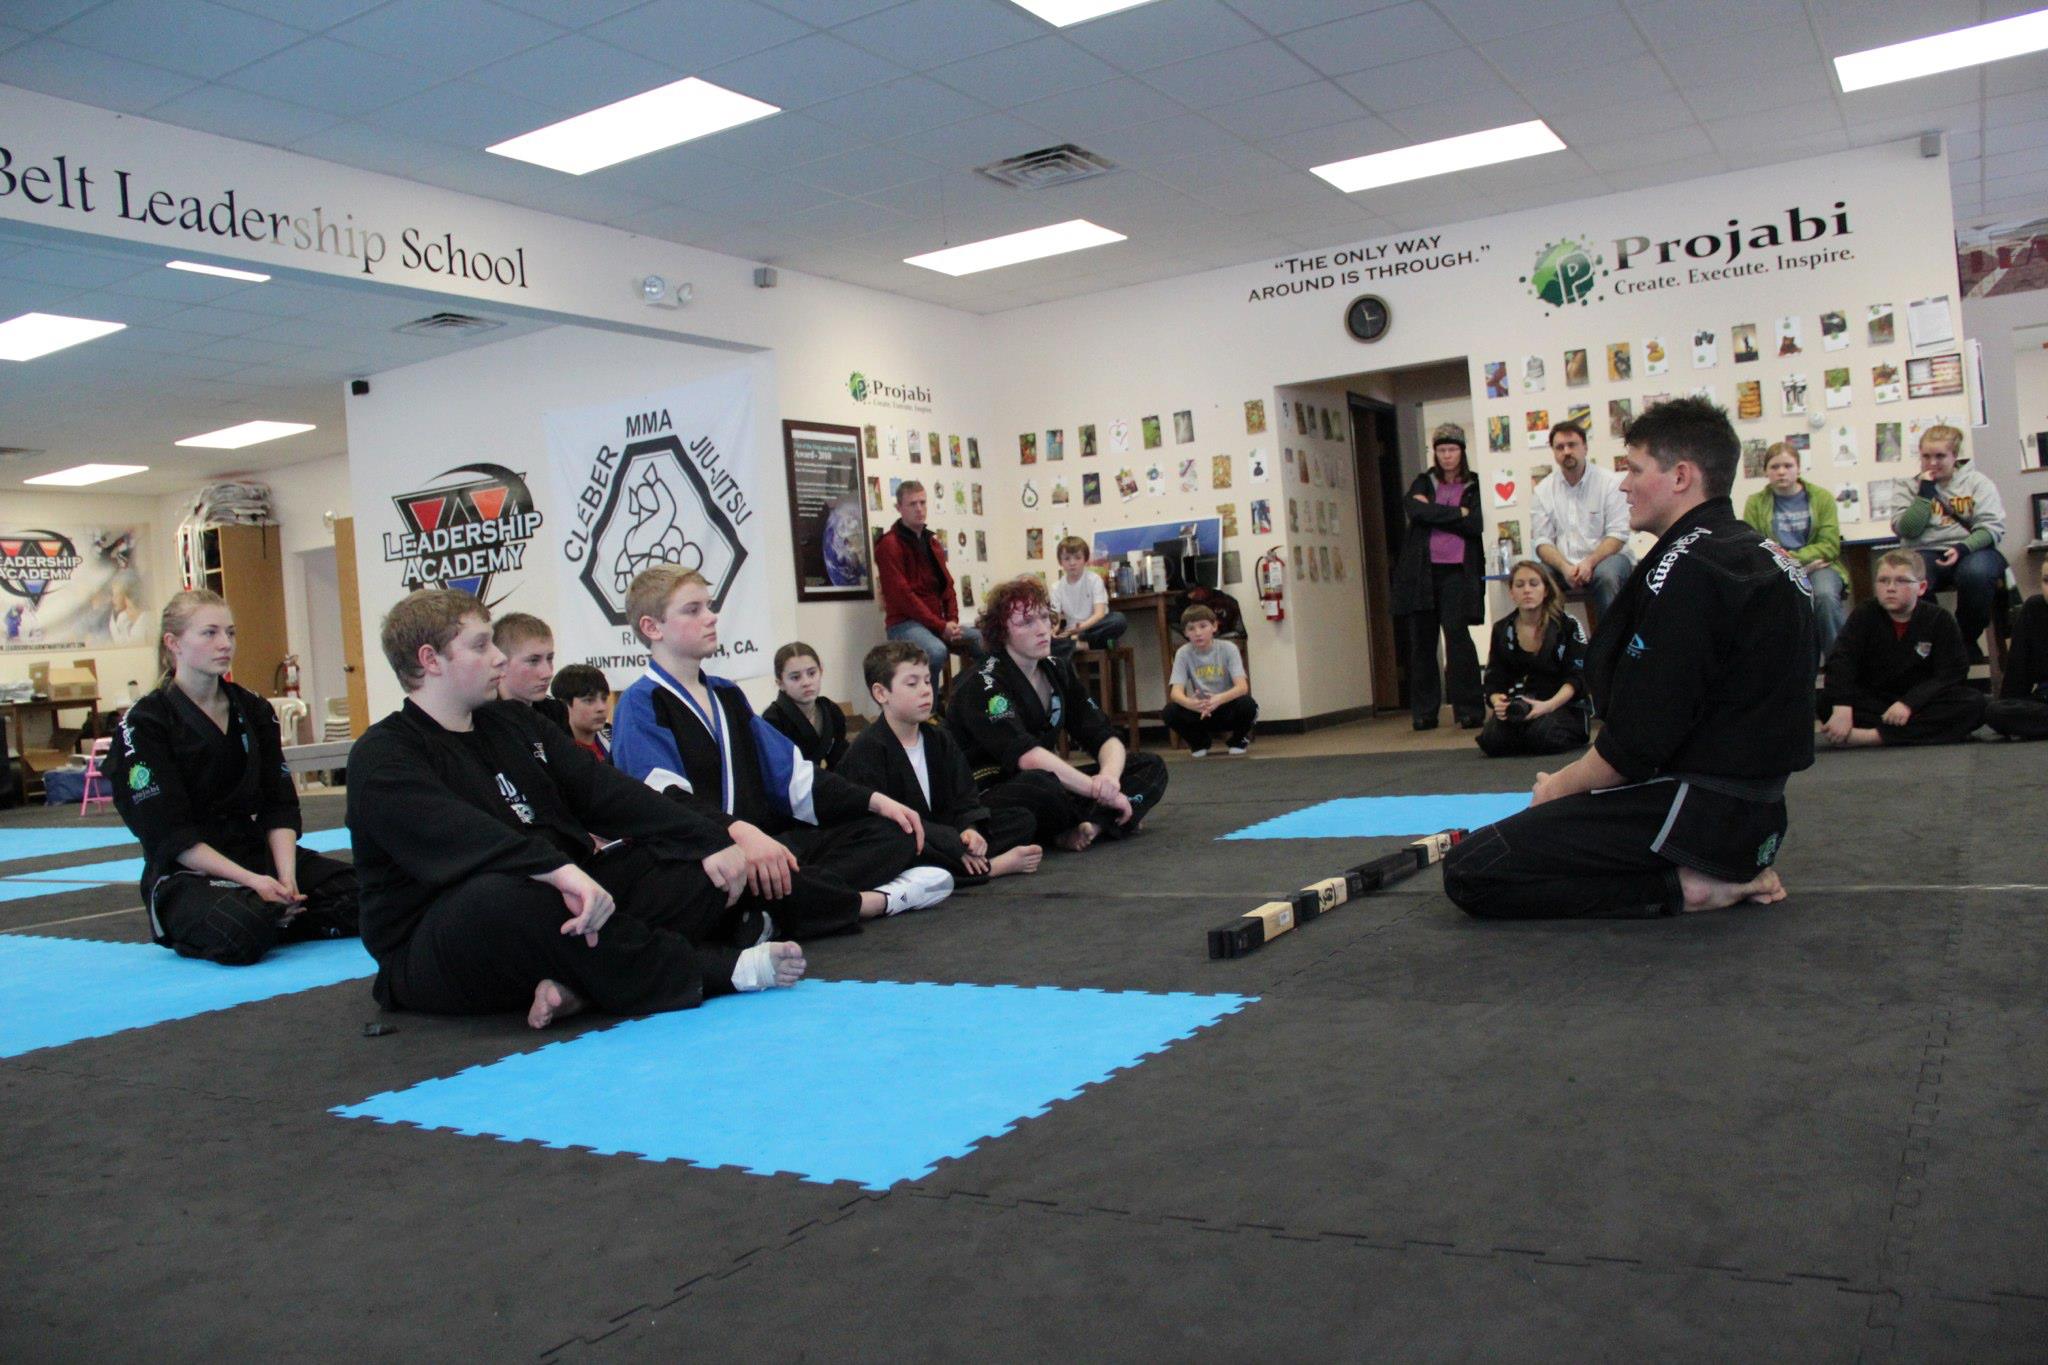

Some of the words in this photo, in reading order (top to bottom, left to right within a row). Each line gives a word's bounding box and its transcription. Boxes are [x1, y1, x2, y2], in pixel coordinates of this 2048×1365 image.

[114, 170, 386, 274] Leadership
[402, 227, 528, 288] School
[1334, 244, 1388, 266] ONLY
[1395, 235, 1442, 255] WAY
[1611, 201, 1854, 272] Projabi
[1248, 275, 1335, 302] AROUND
[1341, 270, 1361, 286] IS
[1614, 277, 1680, 295] Create.
[1688, 261, 1769, 285] Execute.
[1777, 247, 1855, 273] Inspire.
[873, 380, 932, 403] Projabi
[626, 408, 673, 438] MMA
[564, 444, 619, 563] CLEBER
[690, 436, 753, 526] JIU-JITSU
[383, 511, 543, 562] LEADERSHIP
[402, 543, 526, 587] ACADEMY
[734, 640, 758, 655] CA.
